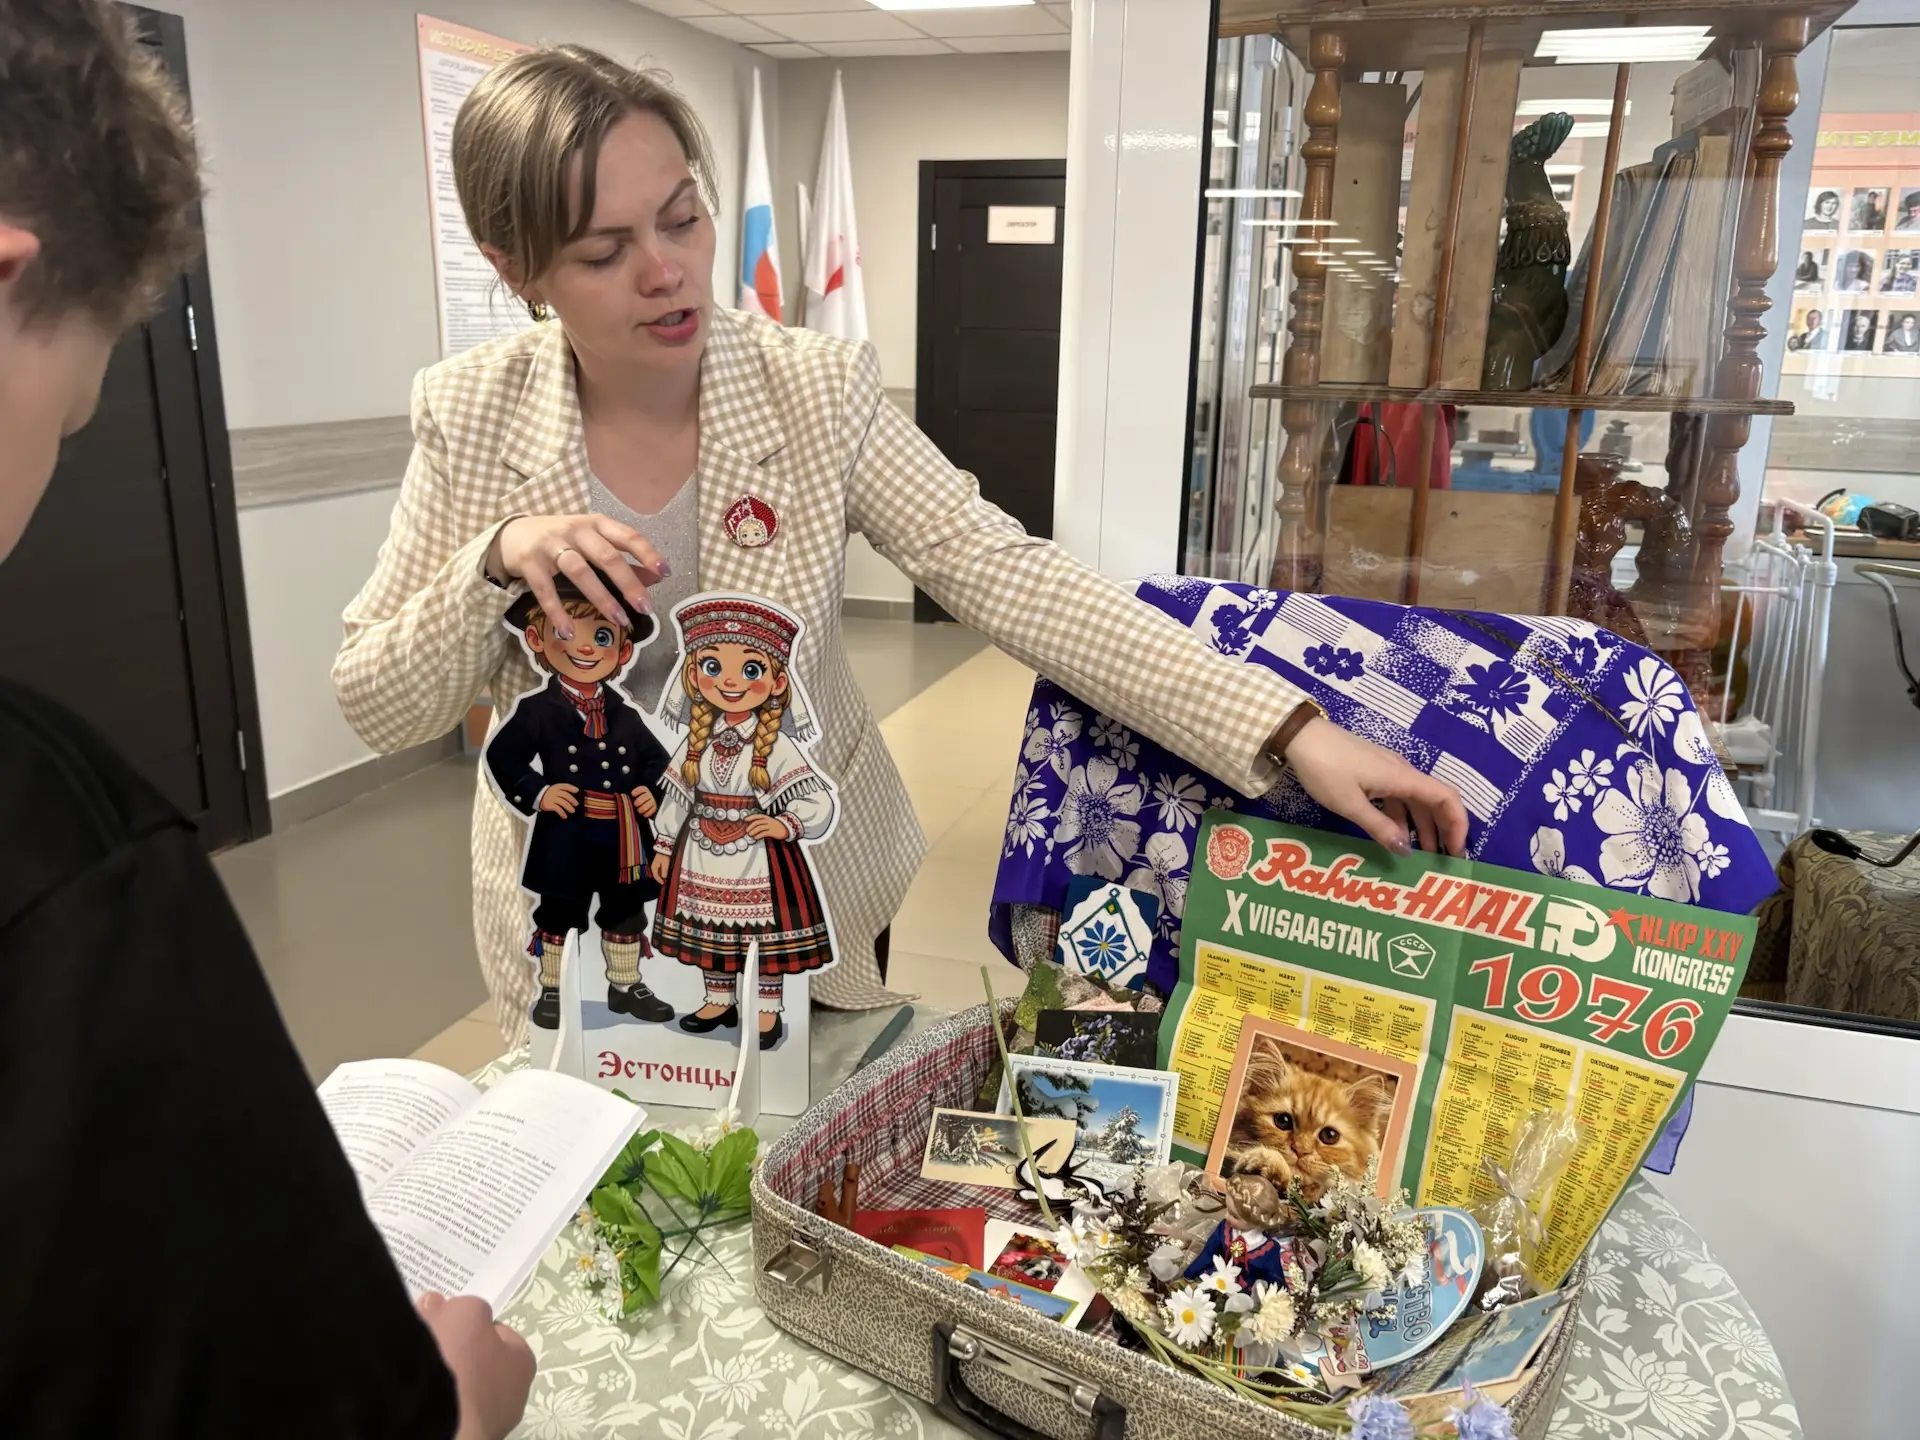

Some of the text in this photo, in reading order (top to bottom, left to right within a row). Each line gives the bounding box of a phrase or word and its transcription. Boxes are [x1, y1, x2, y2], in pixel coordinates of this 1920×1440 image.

[1221, 889, 1383, 962] X VIISAASTAK
[1401, 872, 1540, 946] HÄÄL
[1399, 937, 1426, 951] СССР
[1637, 914, 1744, 964] NLKP XXV
[1631, 945, 1735, 996] KONGRESS
[1467, 952, 1704, 1060] 1976
[1505, 1033, 1528, 1043] AUGUST
[1540, 1042, 1571, 1056] SEPTEMBER
[597, 1051, 737, 1091] Эстонцы
